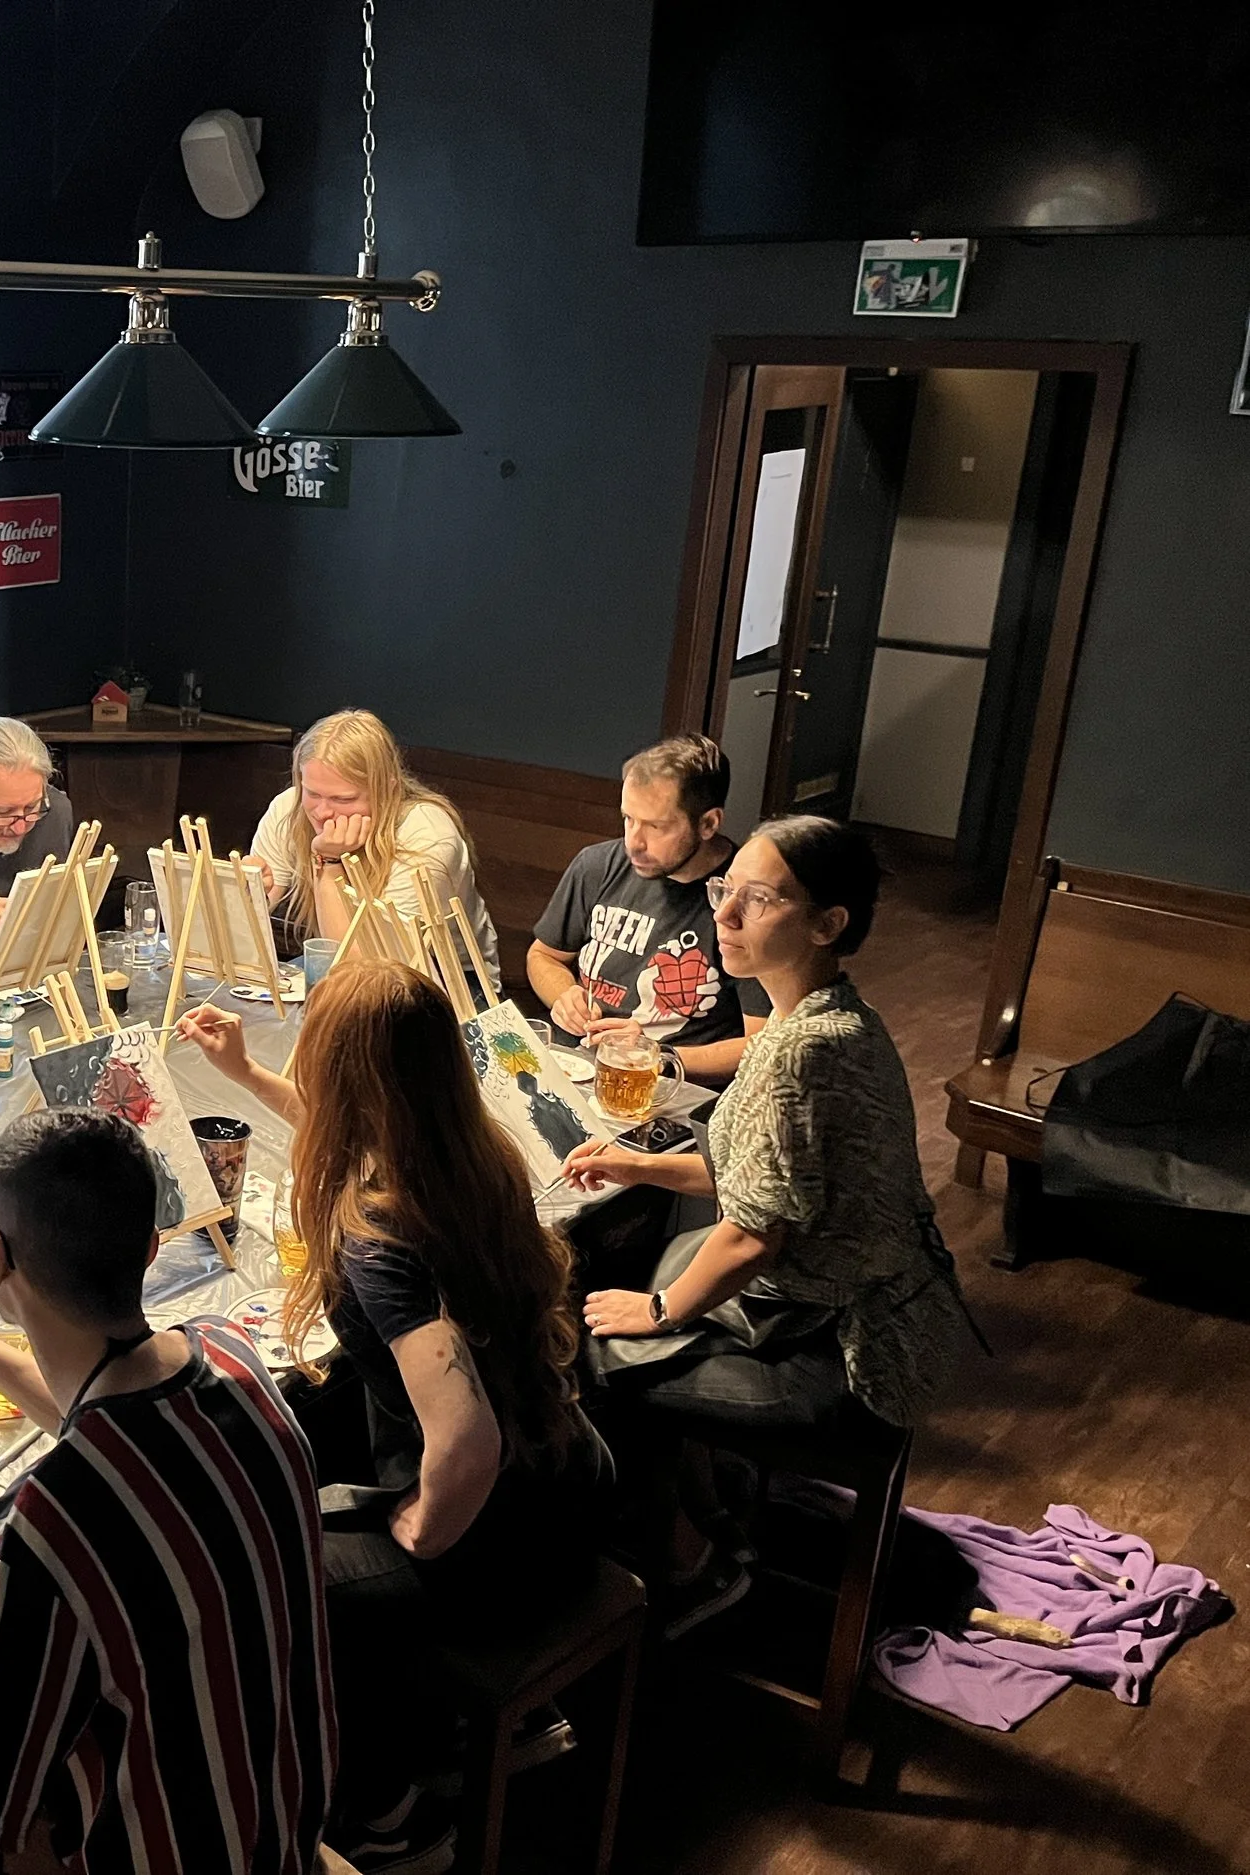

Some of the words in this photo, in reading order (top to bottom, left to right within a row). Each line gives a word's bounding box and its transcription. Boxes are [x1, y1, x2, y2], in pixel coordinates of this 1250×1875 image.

[233, 437, 338, 492] Gösse
[286, 474, 325, 498] Bier
[2, 545, 41, 566] Bier
